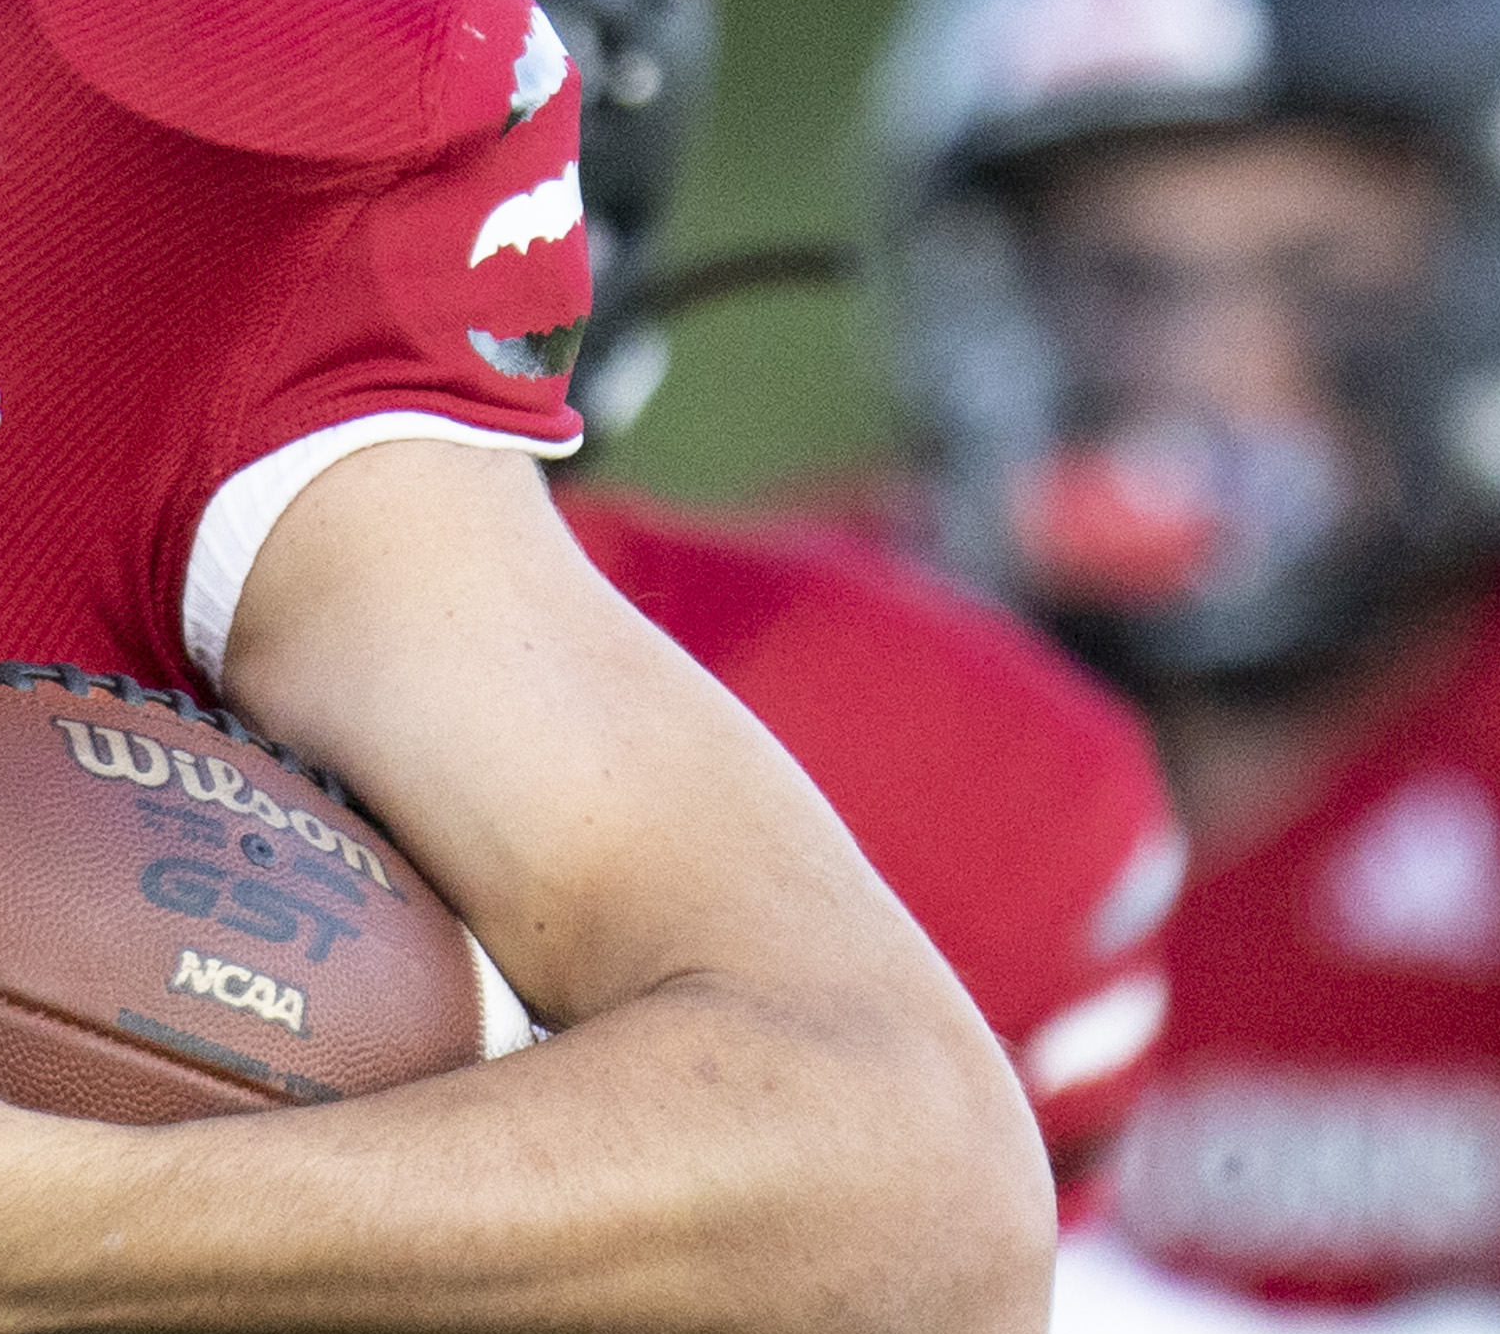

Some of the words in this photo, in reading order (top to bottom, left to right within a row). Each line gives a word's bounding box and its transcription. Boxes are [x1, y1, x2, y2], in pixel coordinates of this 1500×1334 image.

[53, 717, 404, 901] Wilson
[140, 857, 362, 964] GST
[167, 948, 308, 1037] NCAA
